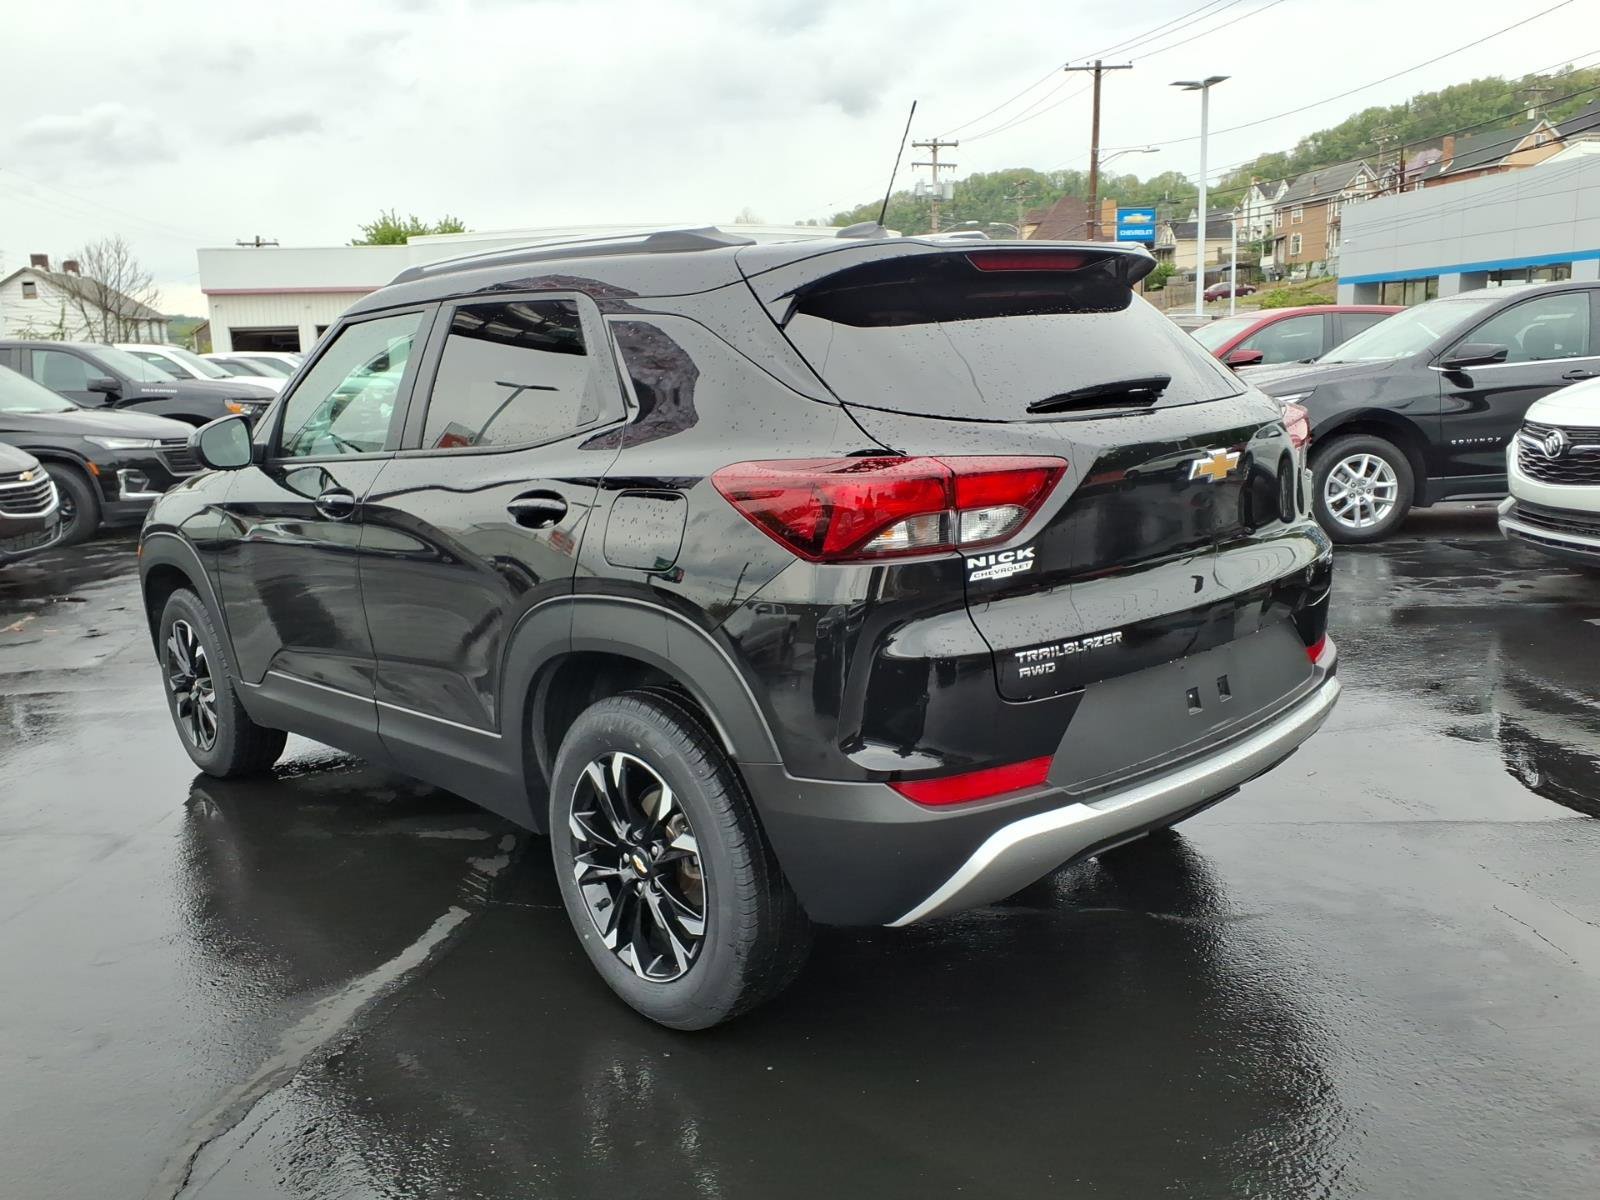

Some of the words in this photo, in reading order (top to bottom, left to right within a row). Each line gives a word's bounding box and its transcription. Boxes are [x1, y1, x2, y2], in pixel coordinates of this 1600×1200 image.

[967, 546, 1035, 569] NICK
[973, 562, 1030, 578] CHEVROLET
[1014, 631, 1123, 664] TRAILBLAZER
[1018, 662, 1056, 679] AWD
